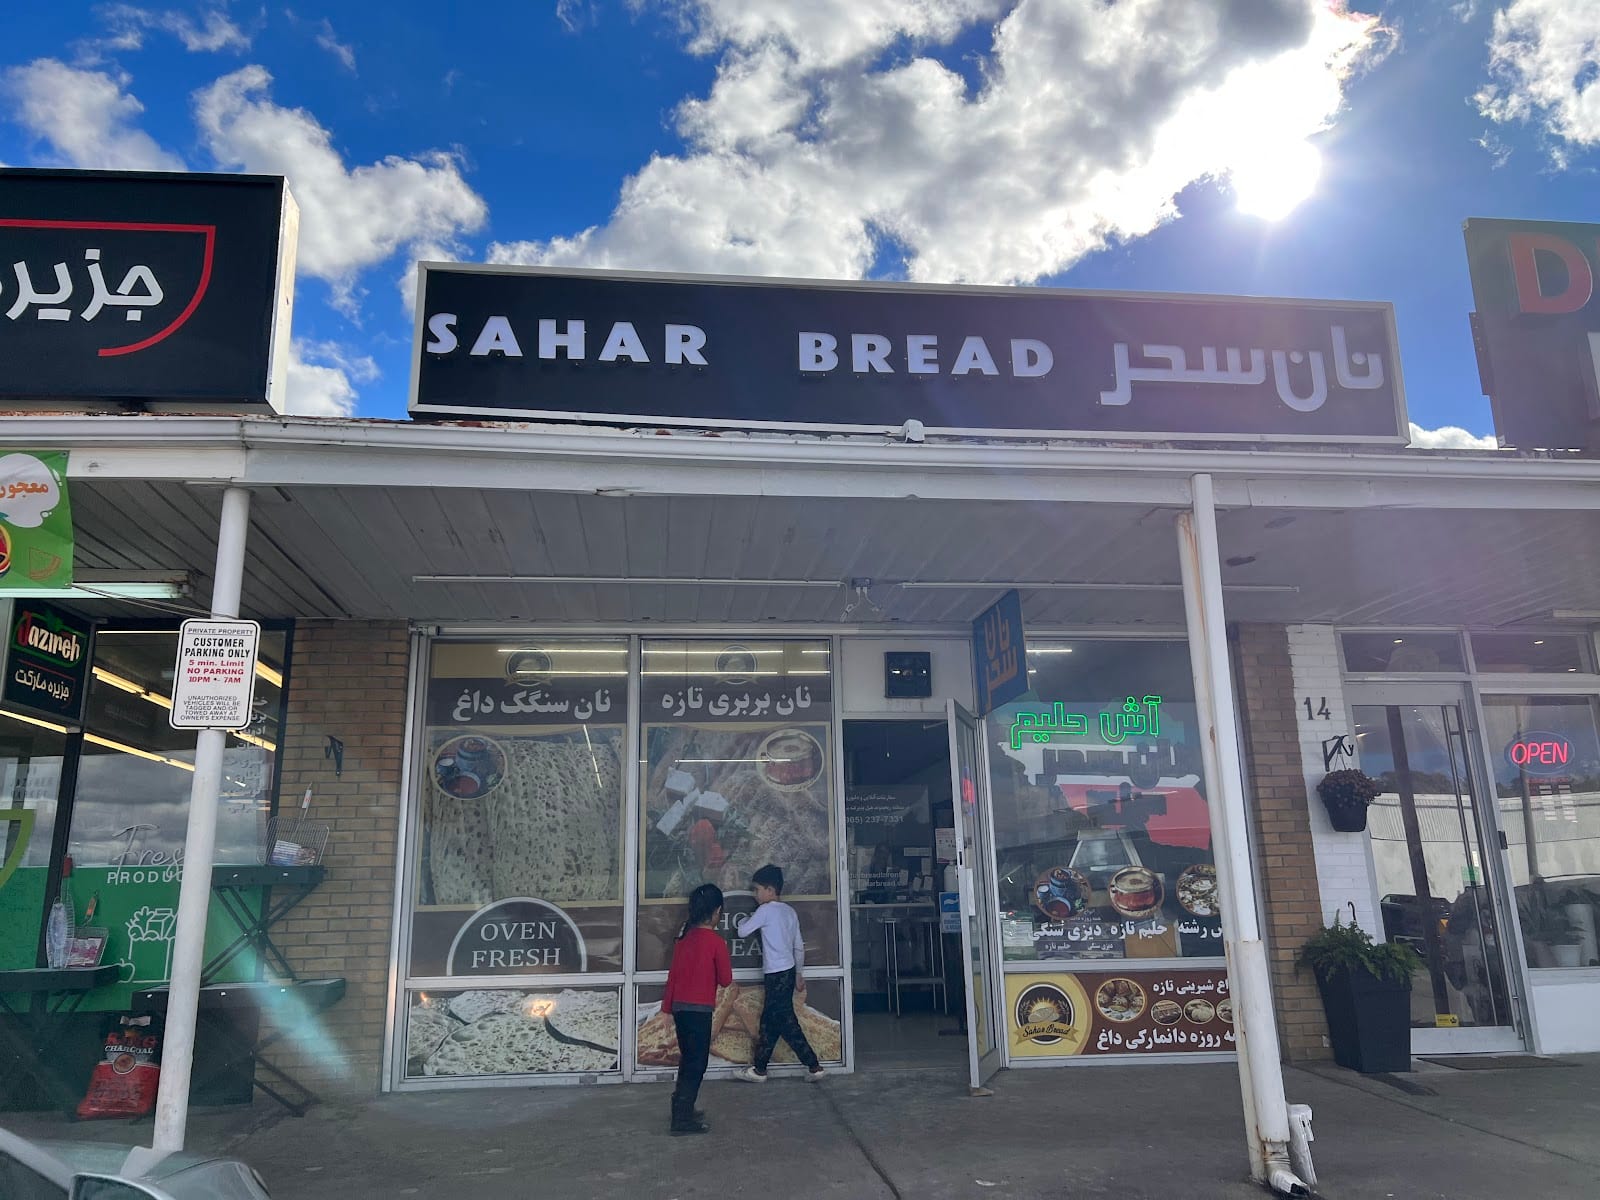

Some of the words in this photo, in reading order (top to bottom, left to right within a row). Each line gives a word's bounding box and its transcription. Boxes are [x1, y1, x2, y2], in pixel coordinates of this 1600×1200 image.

[1507, 232, 1593, 314] D
[0, 248, 164, 322] جزیر
[426, 312, 709, 367] SAHAR
[799, 332, 1054, 378] BREAD
[1100, 341, 1266, 406] سحر
[1273, 325, 1385, 413] نان
[188, 627, 216, 635] PRIVATE
[218, 628, 254, 636] PROPERTY
[193, 637, 245, 648] CUSTOMER
[184, 647, 225, 658] PARKING
[227, 648, 251, 659] ONLY
[220, 660, 245, 668] Limit
[15, 668, 47, 691] مارکت
[187, 667, 201, 675] NO
[203, 667, 245, 676] PARKING
[188, 676, 211, 684] 10PM
[223, 676, 242, 684] 7AM
[48, 681, 69, 701] جزیره
[500, 690, 569, 714] سنگک
[662, 686, 704, 717] تازه
[775, 687, 812, 716] نان
[452, 689, 495, 721] داغ
[573, 689, 612, 719] نان
[708, 690, 771, 716] بربری
[1303, 696, 1332, 721] 14
[1010, 702, 1089, 749] حلیم
[1099, 695, 1162, 745] آش
[1511, 741, 1569, 764] OPEN
[112, 823, 185, 886] Fres
[106, 871, 184, 884] PRODU
[480, 921, 557, 942] OVEN
[1067, 923, 1102, 942] دیزی
[1110, 920, 1135, 940] تازه
[1139, 922, 1168, 939] حلیم
[1178, 919, 1208, 938] رشته
[471, 947, 562, 969] FRESH
[1152, 979, 1174, 996] تازه
[1176, 978, 1215, 996] شیرینی
[1022, 1025, 1046, 1037] Sahar
[1045, 1023, 1072, 1036] Bread
[1096, 1028, 1122, 1050] داغ
[1125, 1027, 1186, 1049] دانمارکی
[1189, 1030, 1221, 1048] روزه
[104, 1045, 154, 1054] CHARCOAL
